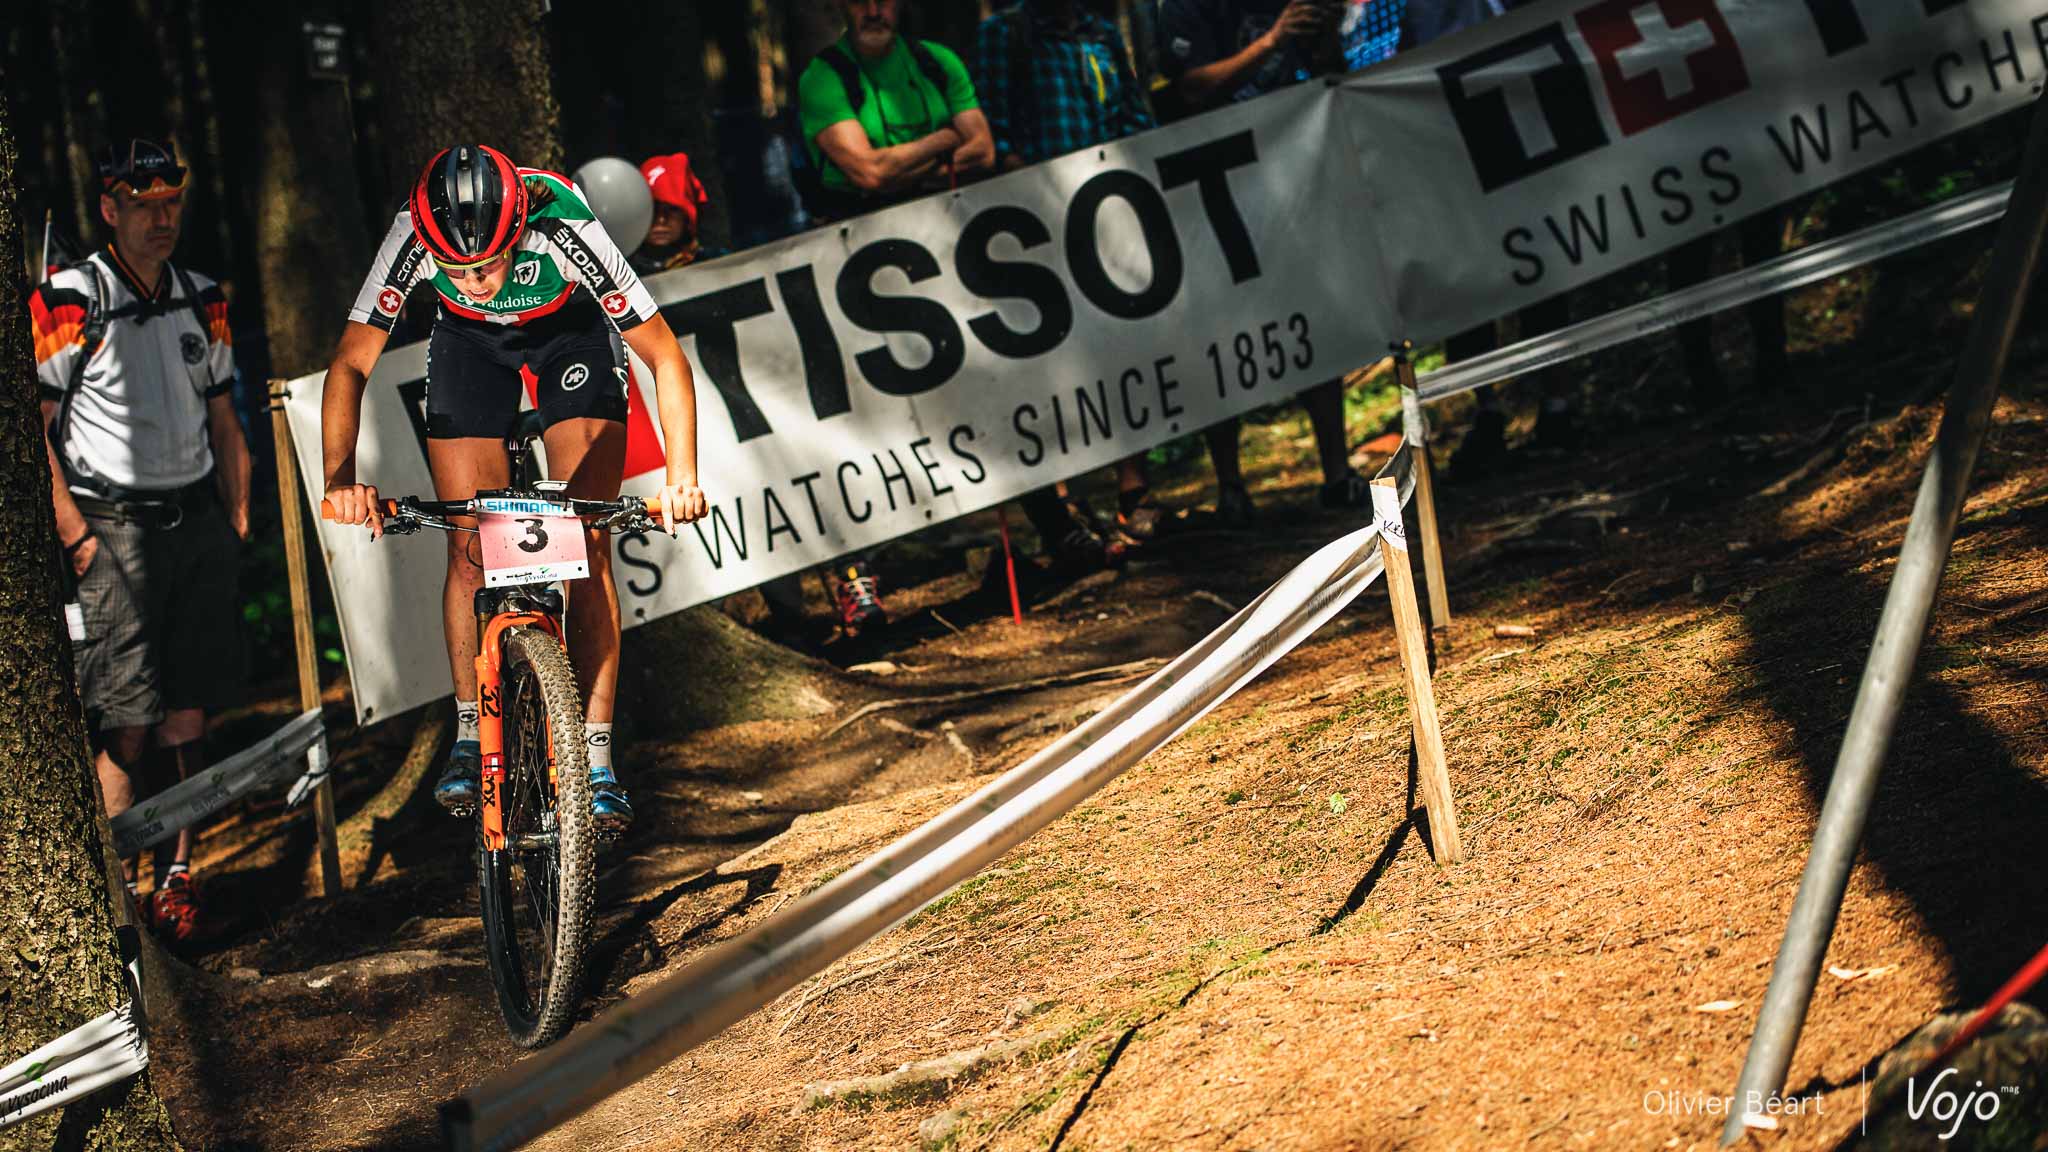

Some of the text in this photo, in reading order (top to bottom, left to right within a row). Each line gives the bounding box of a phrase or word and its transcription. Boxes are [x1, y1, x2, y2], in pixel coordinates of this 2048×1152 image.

[1502, 145, 1742, 287] SWISS
[481, 293, 542, 310] audoise
[658, 128, 1262, 444] TISSOT
[693, 424, 985, 570] WATCHES
[1012, 354, 1185, 467] SINCE
[1207, 311, 1315, 399] 1853
[514, 518, 549, 553] 3
[480, 683, 501, 718] 32
[483, 775, 496, 808] OX
